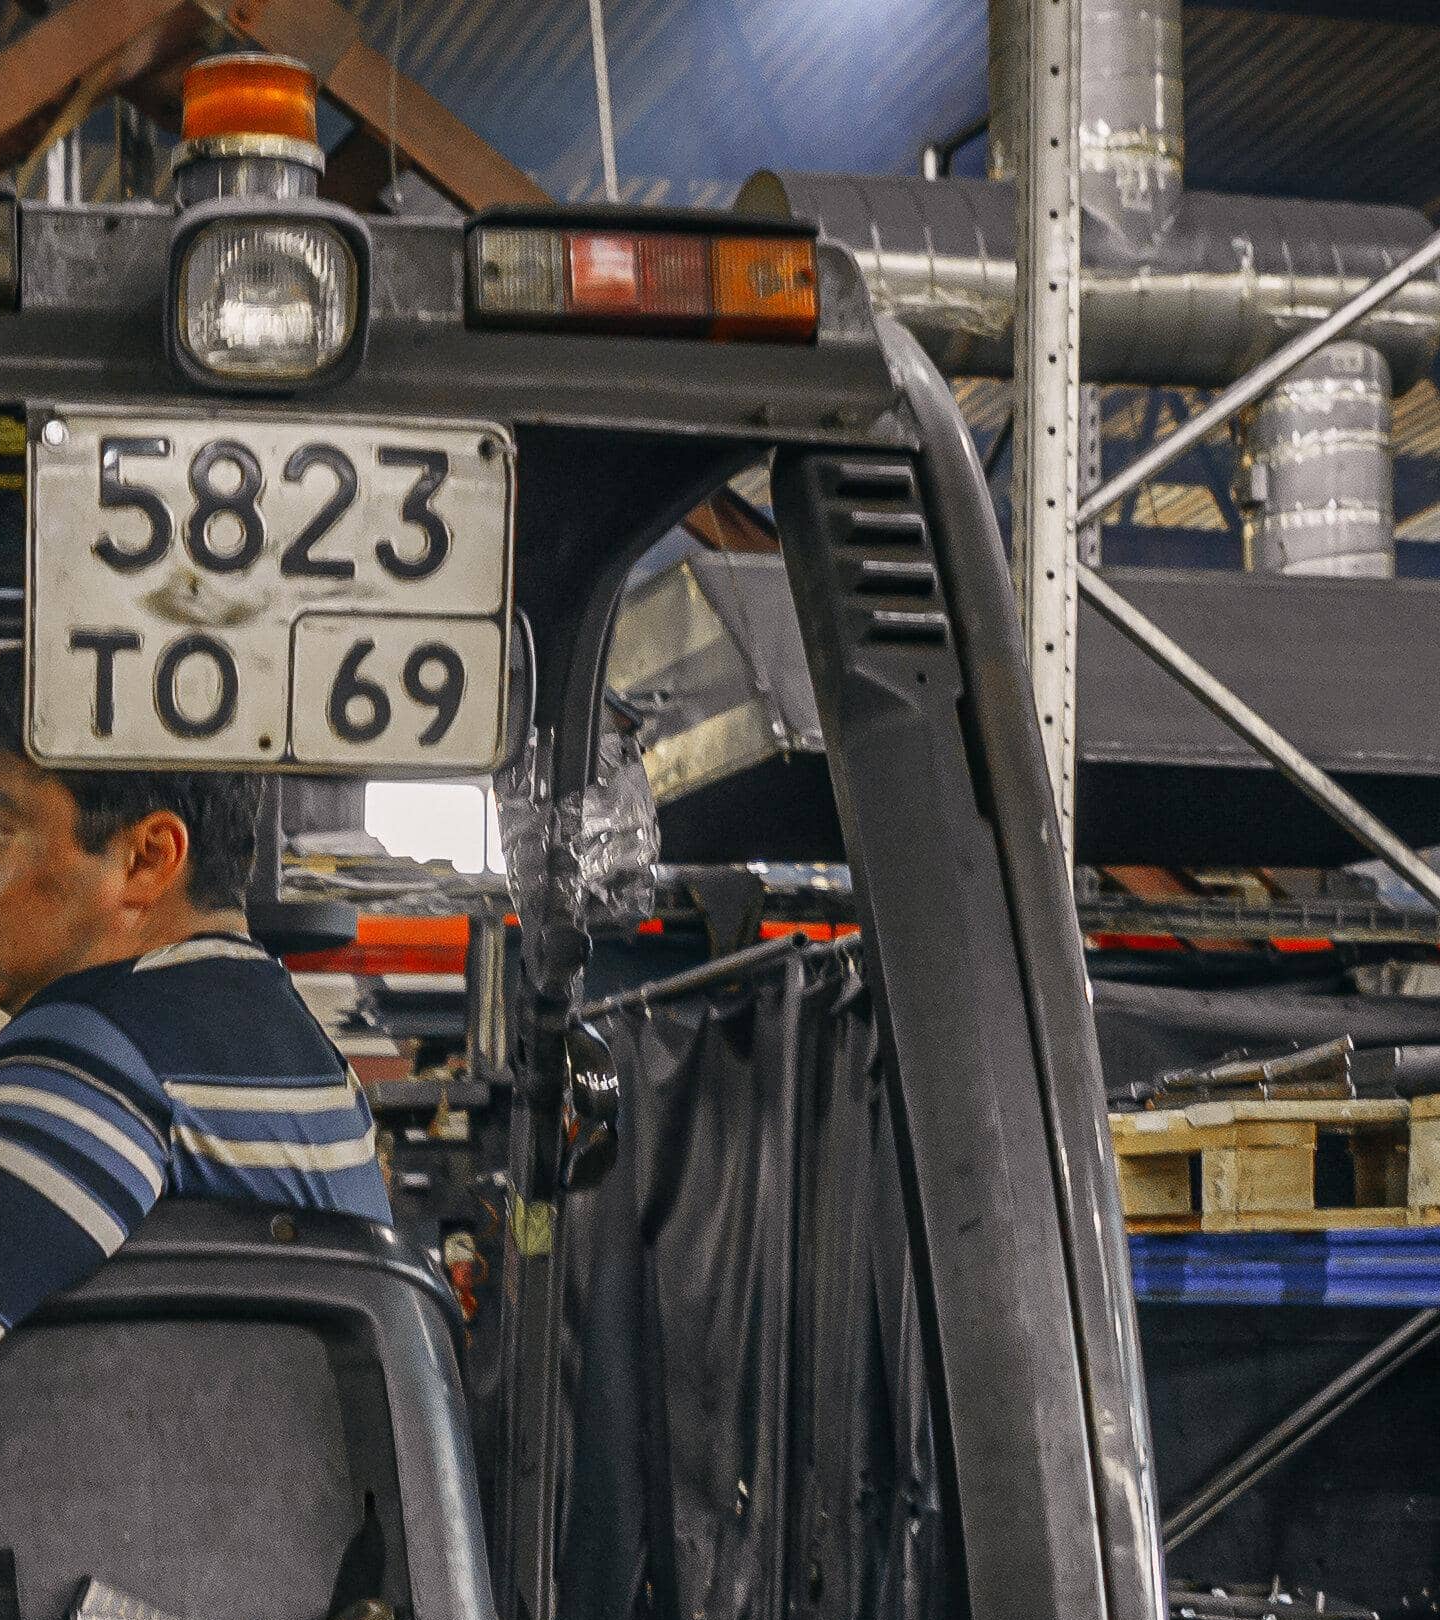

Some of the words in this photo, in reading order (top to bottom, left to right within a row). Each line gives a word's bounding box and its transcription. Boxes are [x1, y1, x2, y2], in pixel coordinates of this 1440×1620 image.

[93, 435, 454, 582] 5823
[69, 628, 240, 741] TO
[326, 637, 467, 749] 69
